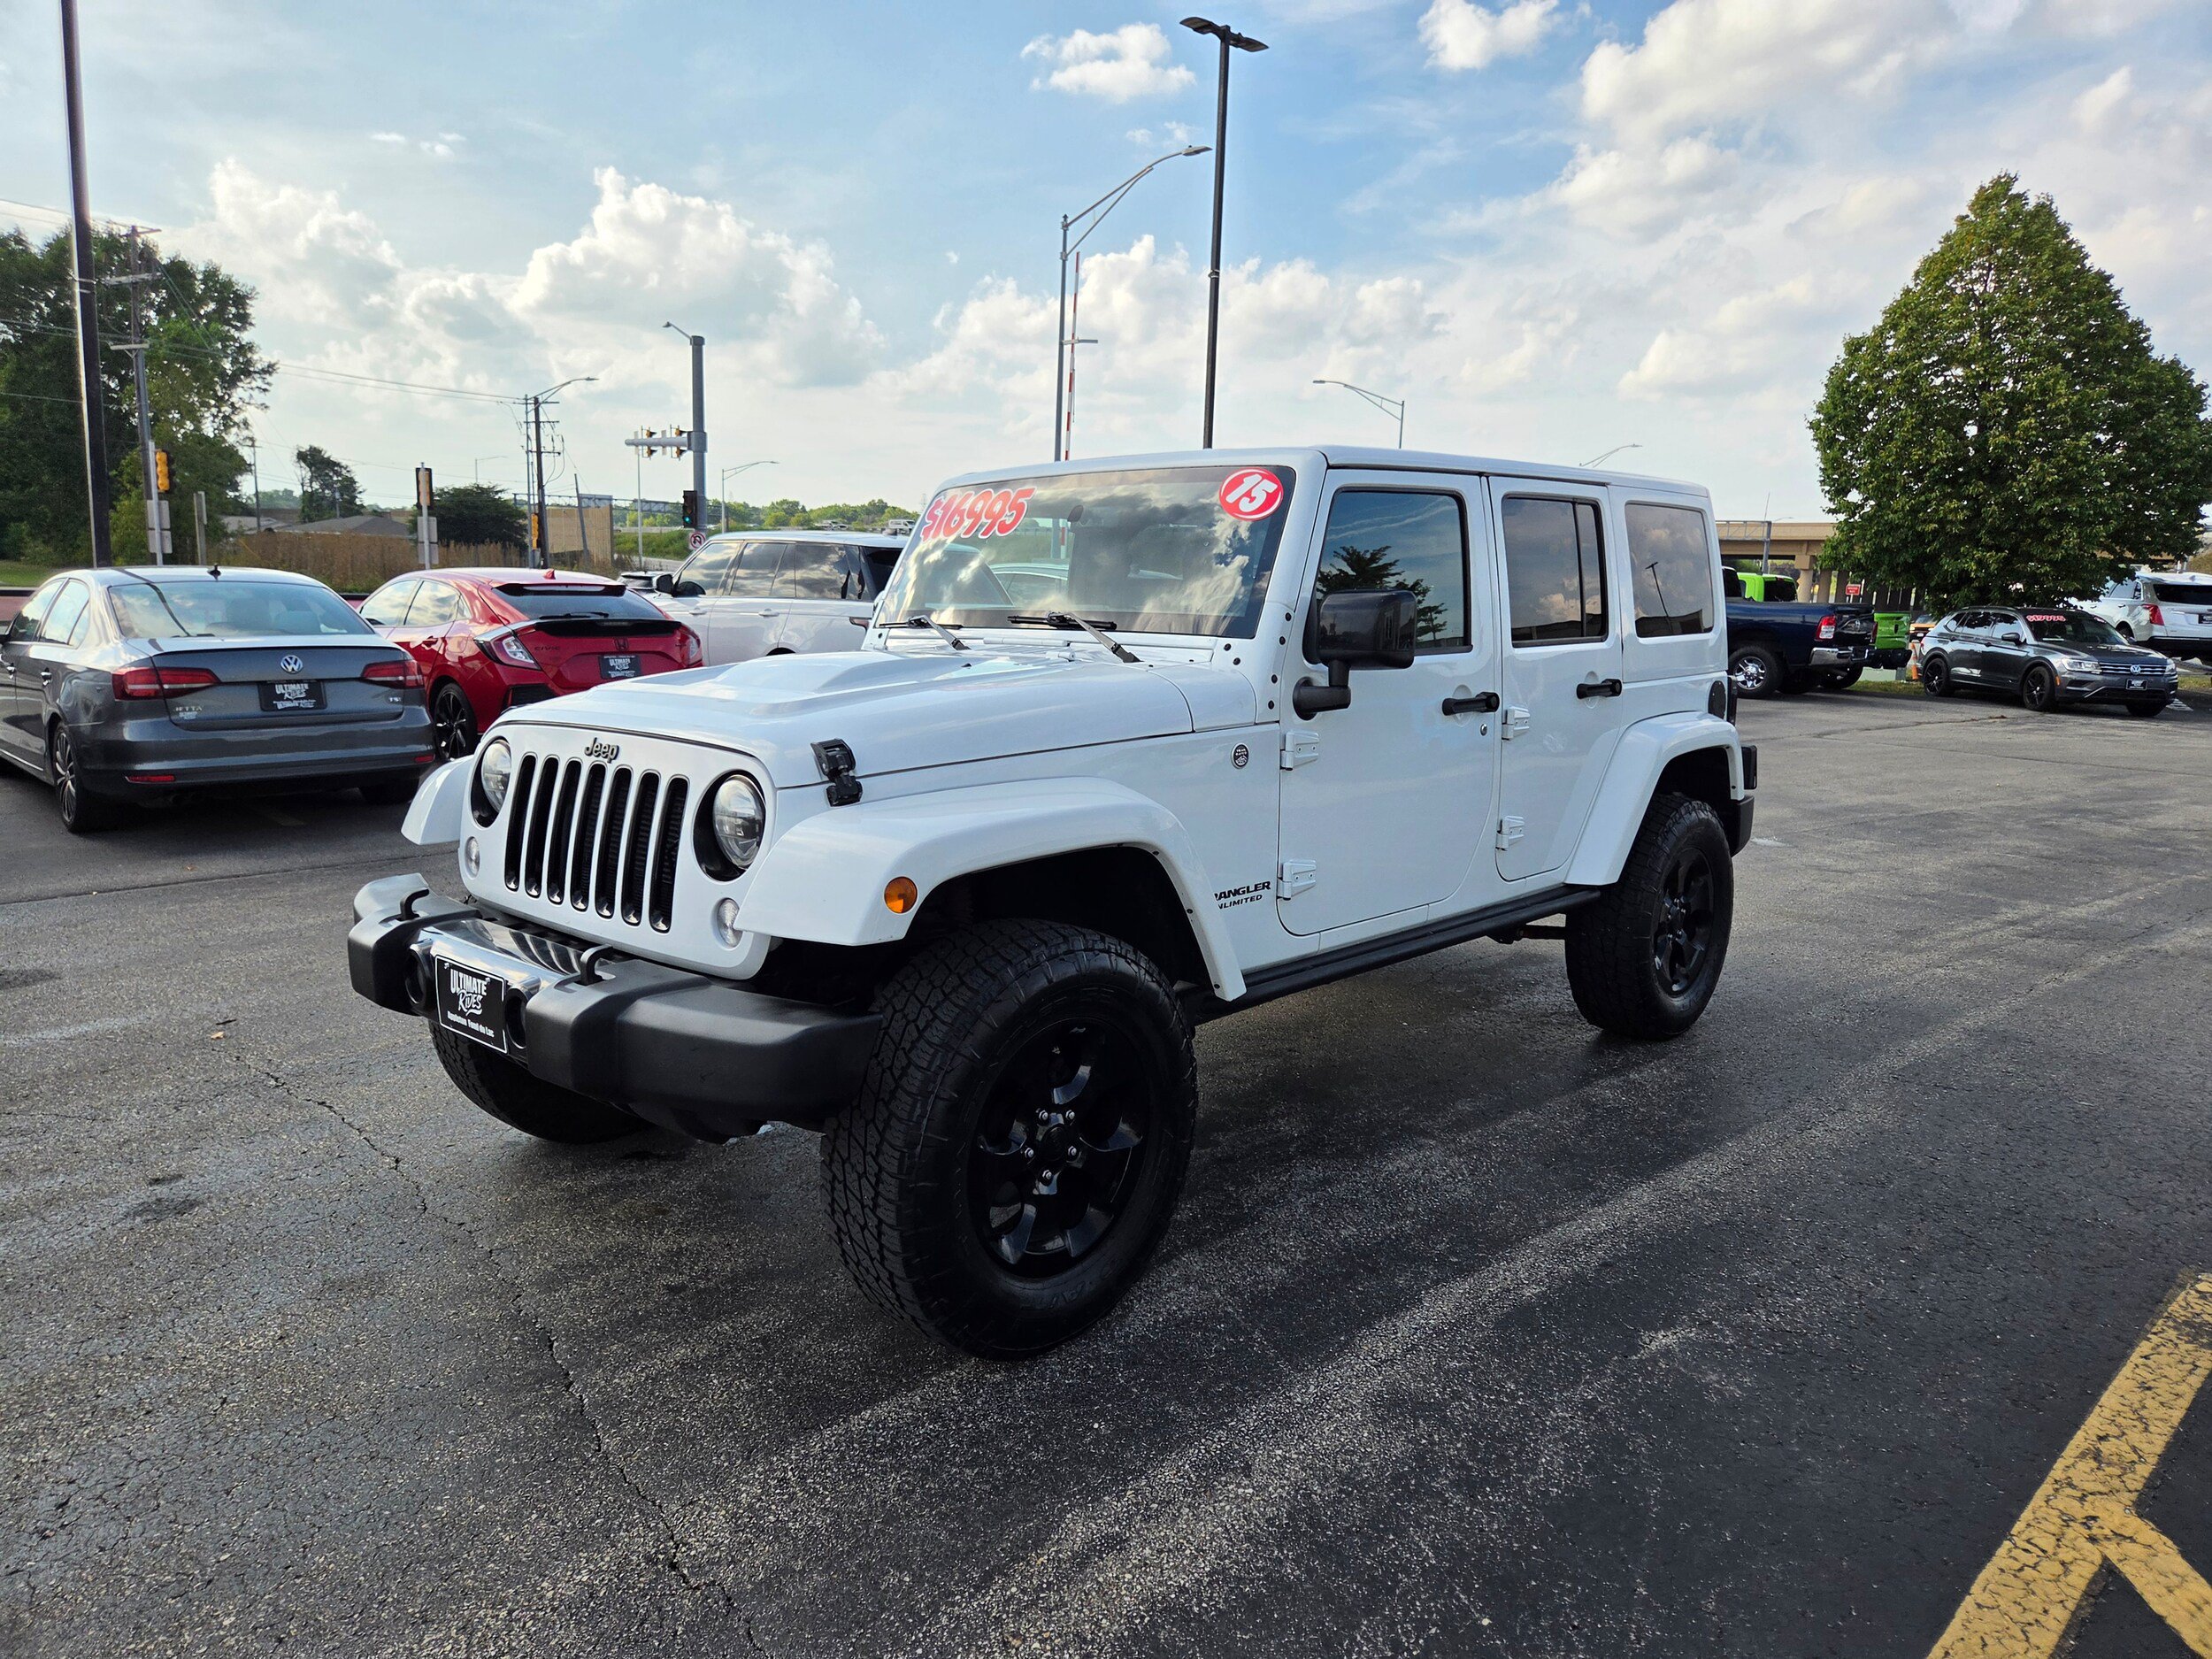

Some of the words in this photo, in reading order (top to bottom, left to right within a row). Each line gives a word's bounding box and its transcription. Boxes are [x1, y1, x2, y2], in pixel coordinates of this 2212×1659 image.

[1226, 473, 1278, 512] 15
[920, 487, 1036, 542] $16995
[275, 683, 309, 695] ULTIMATE
[585, 737, 619, 764] Jeep
[1214, 881, 1271, 901] ANGLER
[1218, 895, 1263, 910] NLIMITED
[450, 969, 487, 995] ULTIMATE
